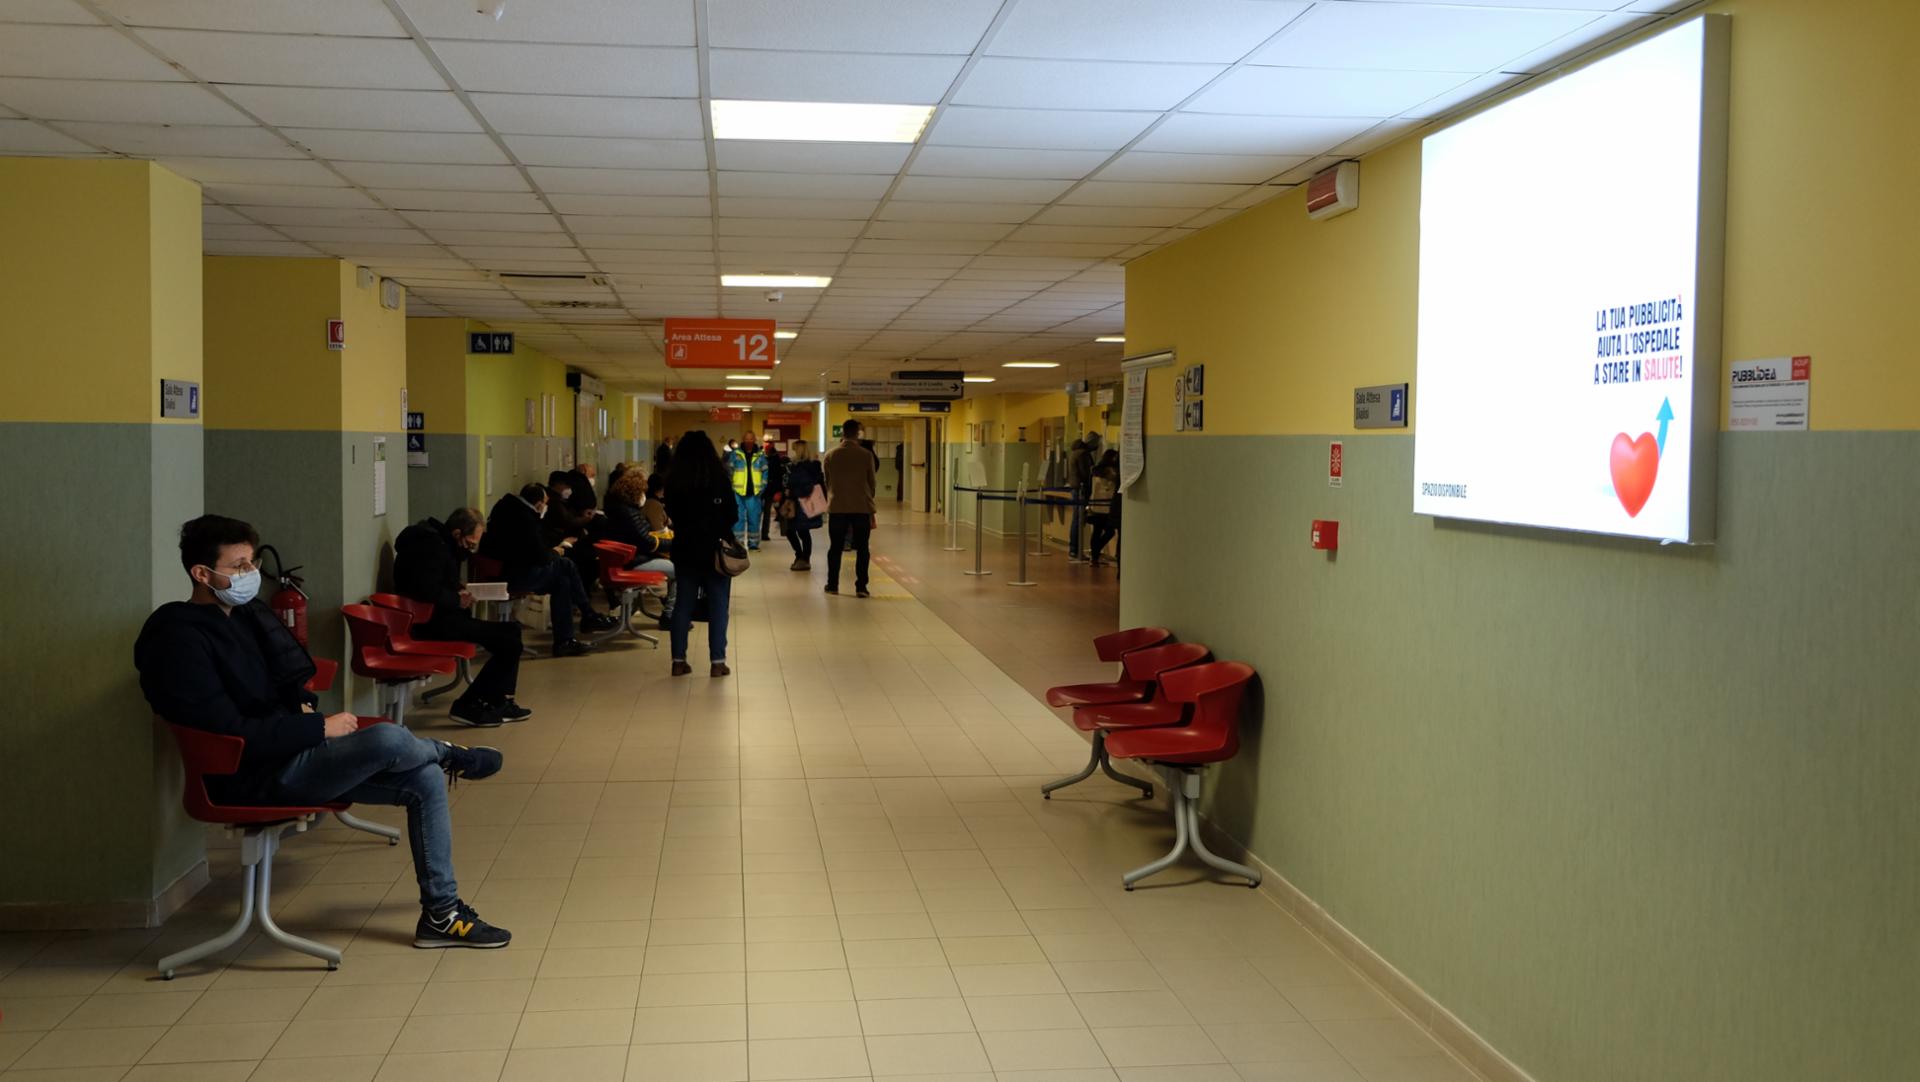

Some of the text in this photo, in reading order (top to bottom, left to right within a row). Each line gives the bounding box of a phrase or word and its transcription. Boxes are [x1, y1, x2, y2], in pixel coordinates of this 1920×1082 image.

[1596, 309, 1606, 332] LA
[1610, 306, 1626, 330] TUA
[672, 333, 722, 342] Area Attesa
[733, 334, 769, 361] 12
[1597, 326, 1680, 358] AIUTA L'OSPEDALE
[1594, 355, 1683, 385] A STARE IN SALUTE!
[448, 919, 474, 937] N
